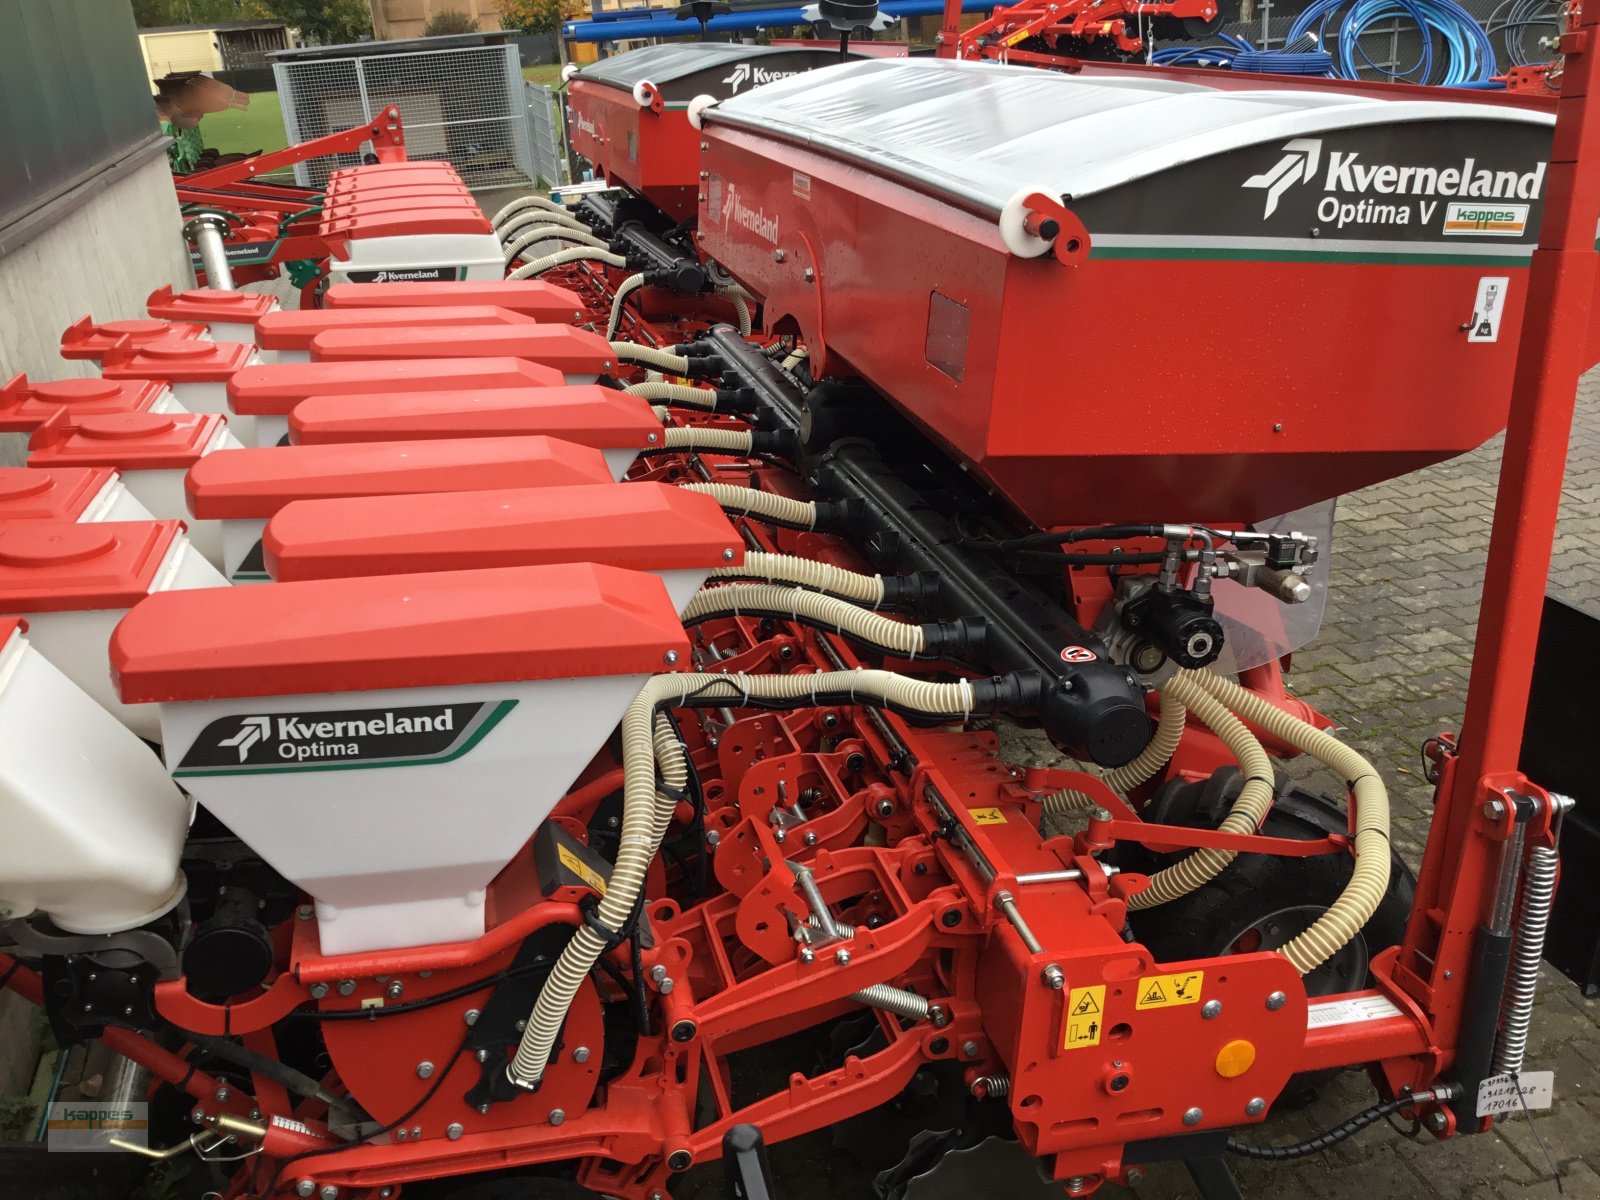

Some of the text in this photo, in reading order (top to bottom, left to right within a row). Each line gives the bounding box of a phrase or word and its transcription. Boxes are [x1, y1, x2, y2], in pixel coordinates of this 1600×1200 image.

[1325, 152, 1545, 199] Kverneland
[734, 194, 778, 245] Kverneland
[1318, 198, 1438, 227] Optima V
[1456, 208, 1515, 230] kappes
[388, 270, 439, 280] Kverneland
[277, 709, 454, 740] Kverneland
[278, 742, 360, 762] Optima
